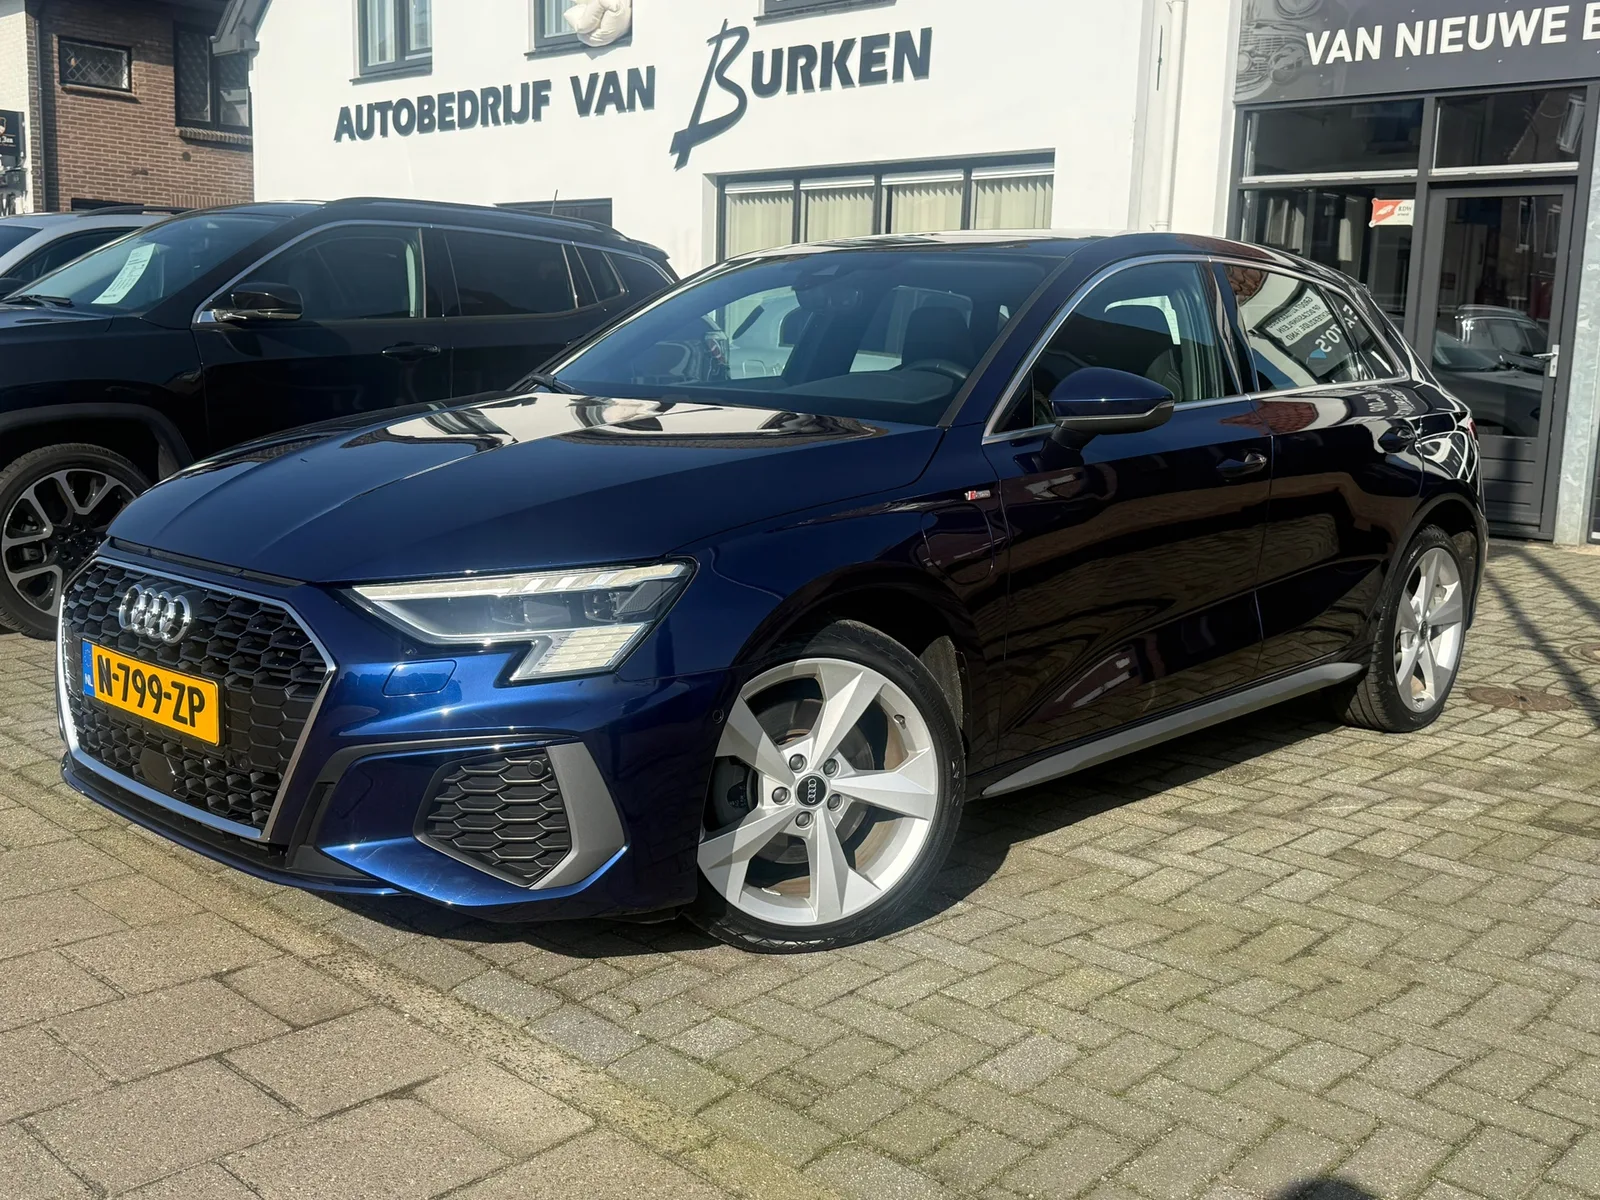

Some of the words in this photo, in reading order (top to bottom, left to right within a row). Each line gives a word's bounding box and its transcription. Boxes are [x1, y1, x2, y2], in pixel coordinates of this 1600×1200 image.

[1305, 25, 1383, 66] VAN
[1394, 5, 1570, 58] NIEUWE
[333, 79, 552, 143] AUTOBEDRIJF
[571, 65, 656, 117] VAN
[669, 18, 933, 170] BURKEN
[97, 654, 206, 728] N-799-ZP
